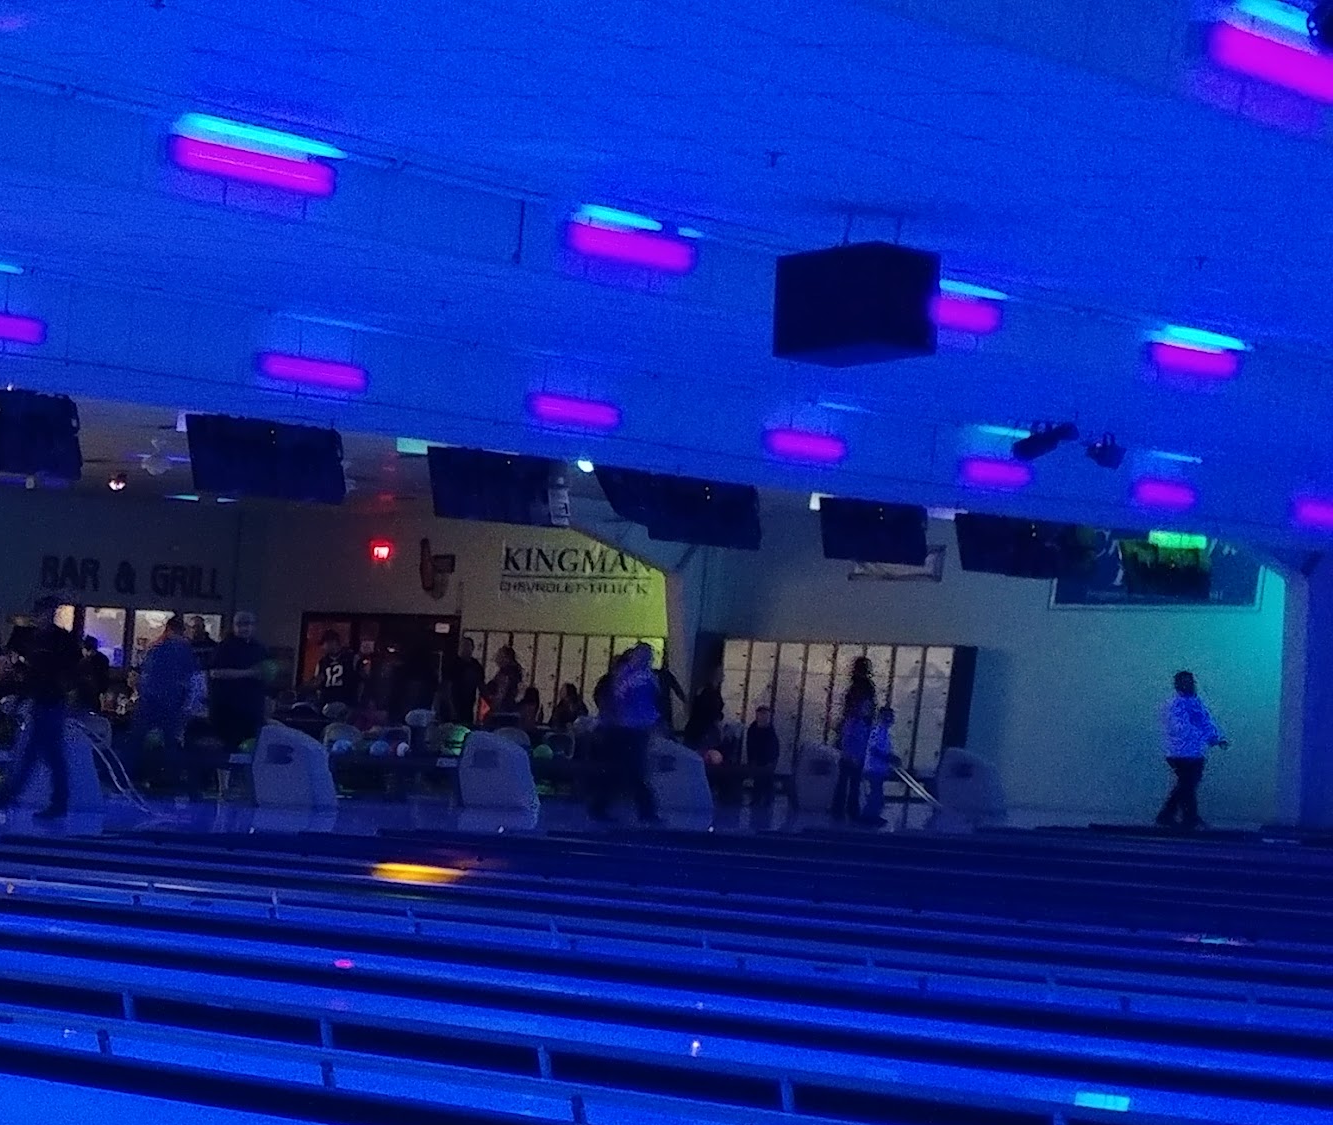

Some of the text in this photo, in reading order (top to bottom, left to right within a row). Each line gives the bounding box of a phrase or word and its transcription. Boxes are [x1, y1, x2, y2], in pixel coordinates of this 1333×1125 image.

[41, 555, 100, 591] BAR
[150, 564, 223, 601] GRILL
[325, 664, 344, 688] 12
